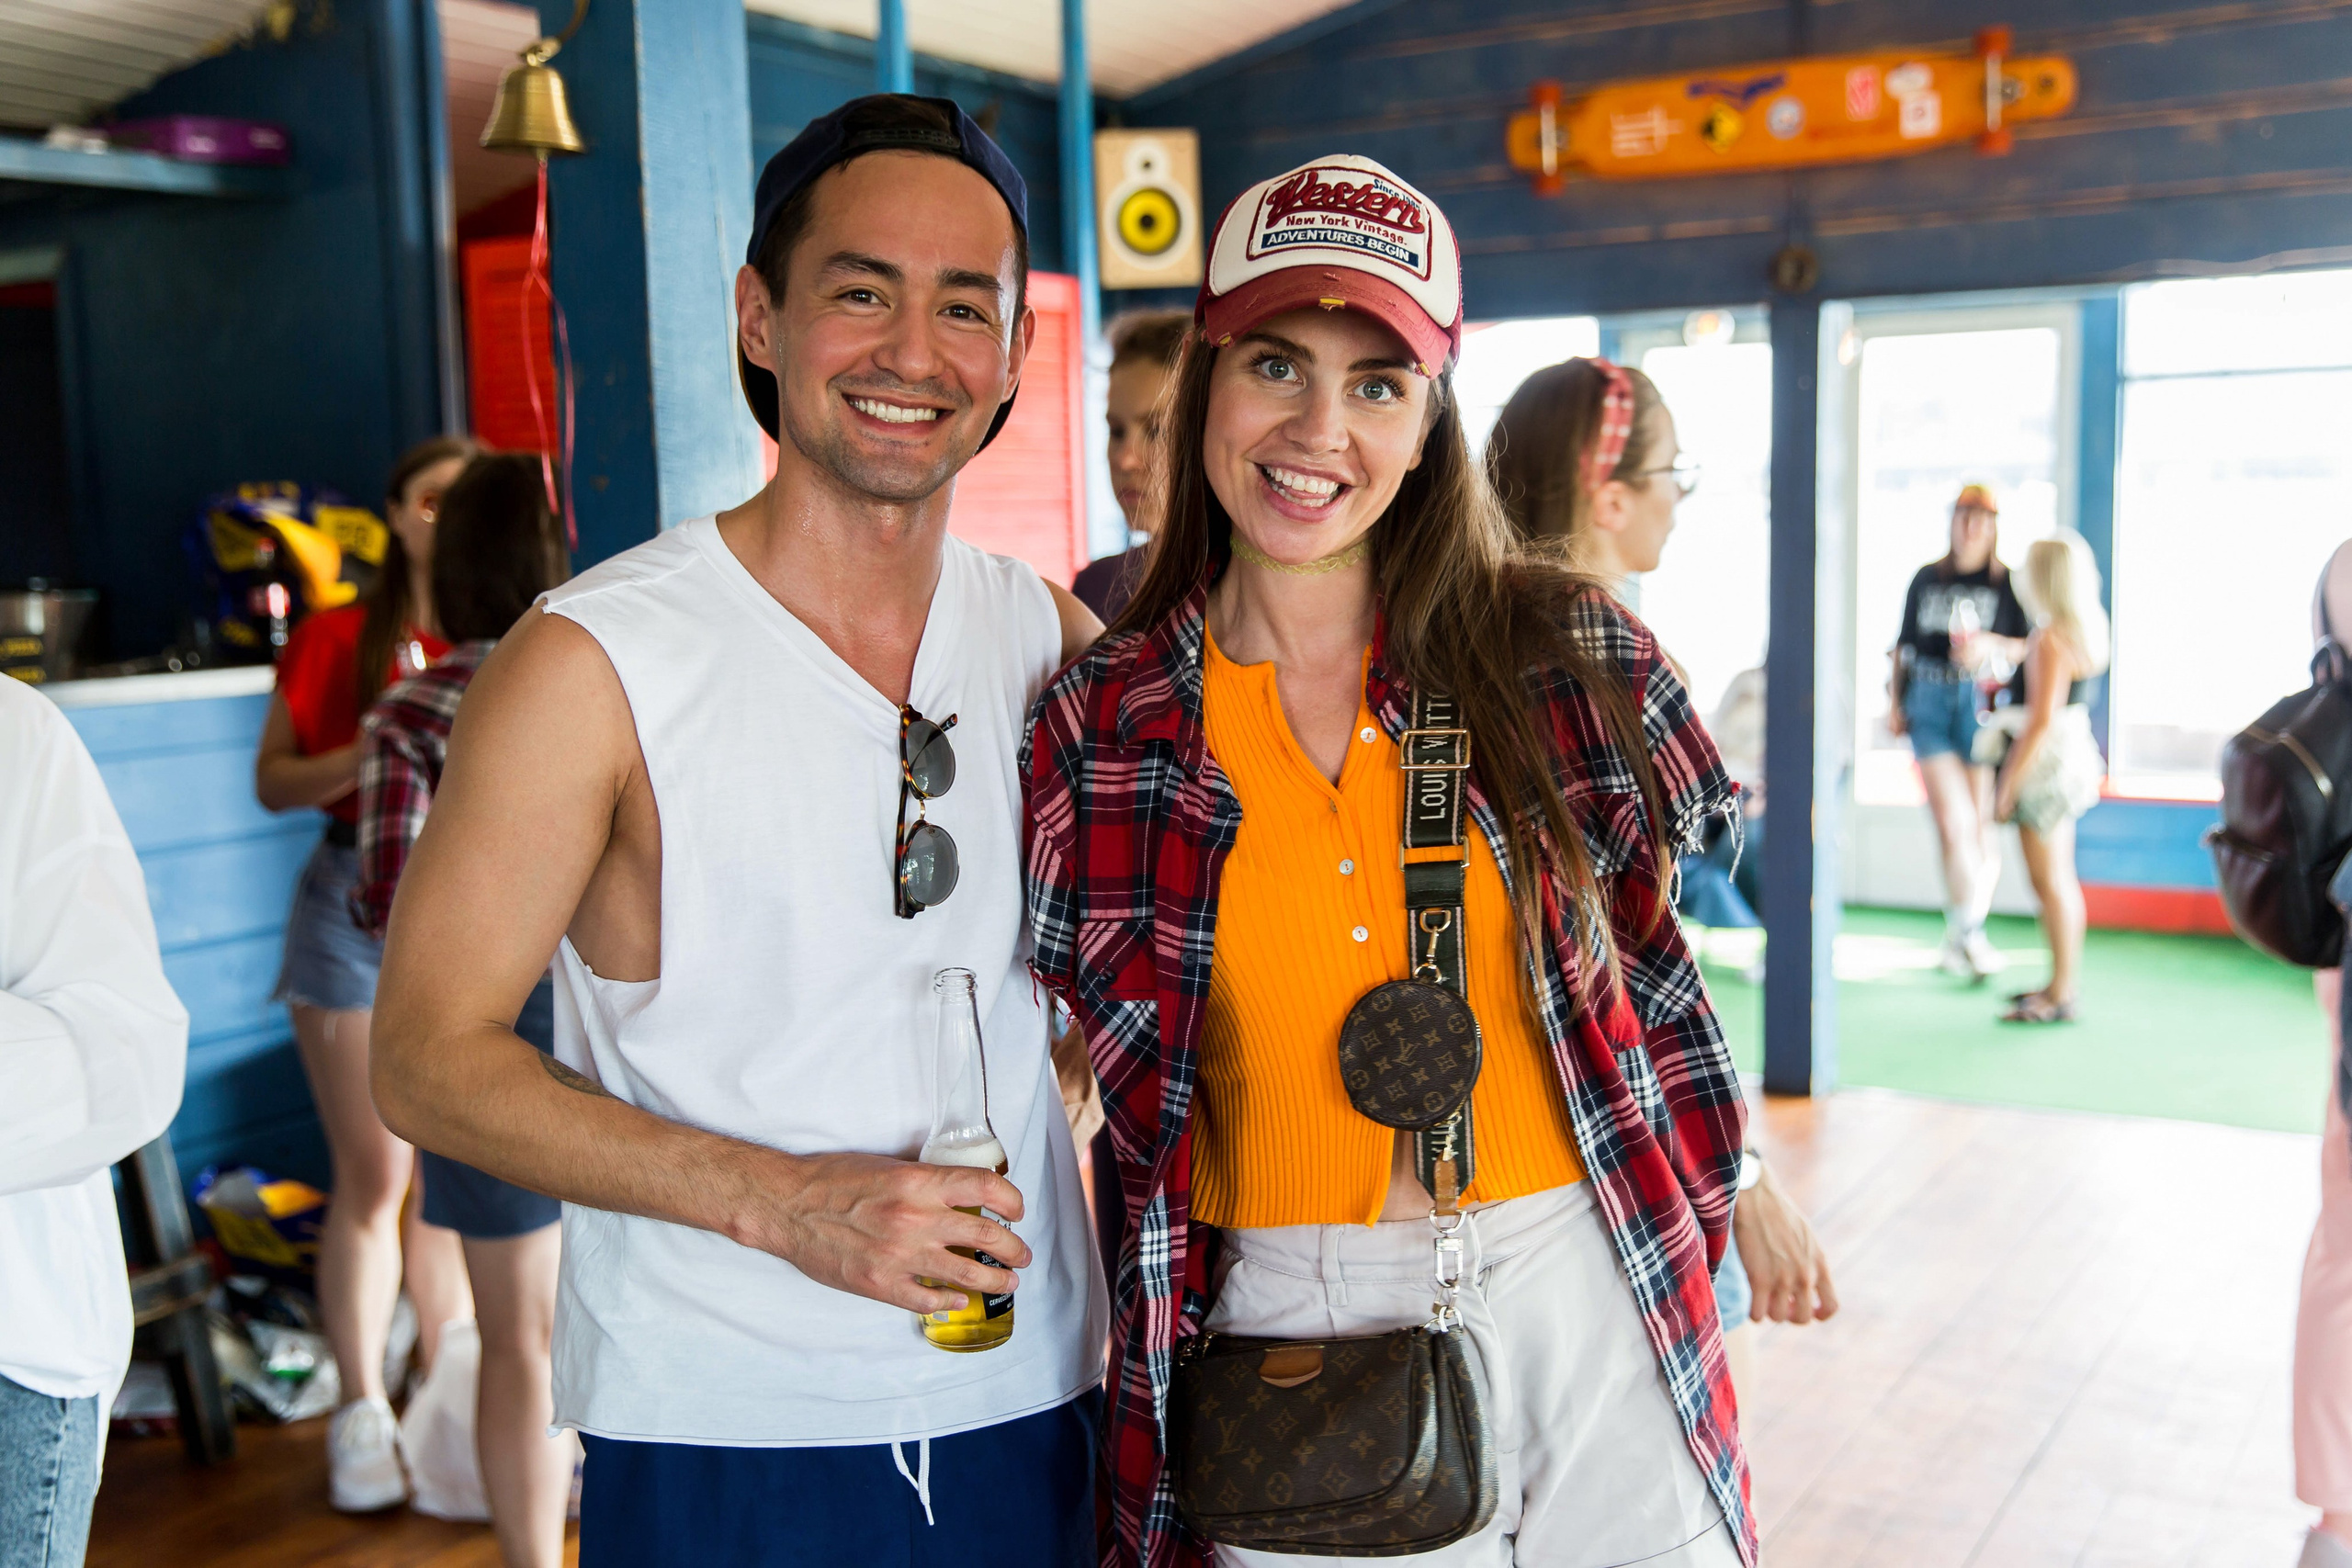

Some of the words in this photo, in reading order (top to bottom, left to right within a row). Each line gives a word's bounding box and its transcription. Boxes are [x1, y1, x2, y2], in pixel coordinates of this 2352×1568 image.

[1265, 171, 1425, 233] Western
[1286, 215, 1315, 226] New
[1320, 214, 1350, 227] York
[1267, 230, 1365, 246] ADVENTURES
[1367, 237, 1409, 262] BEGIN
